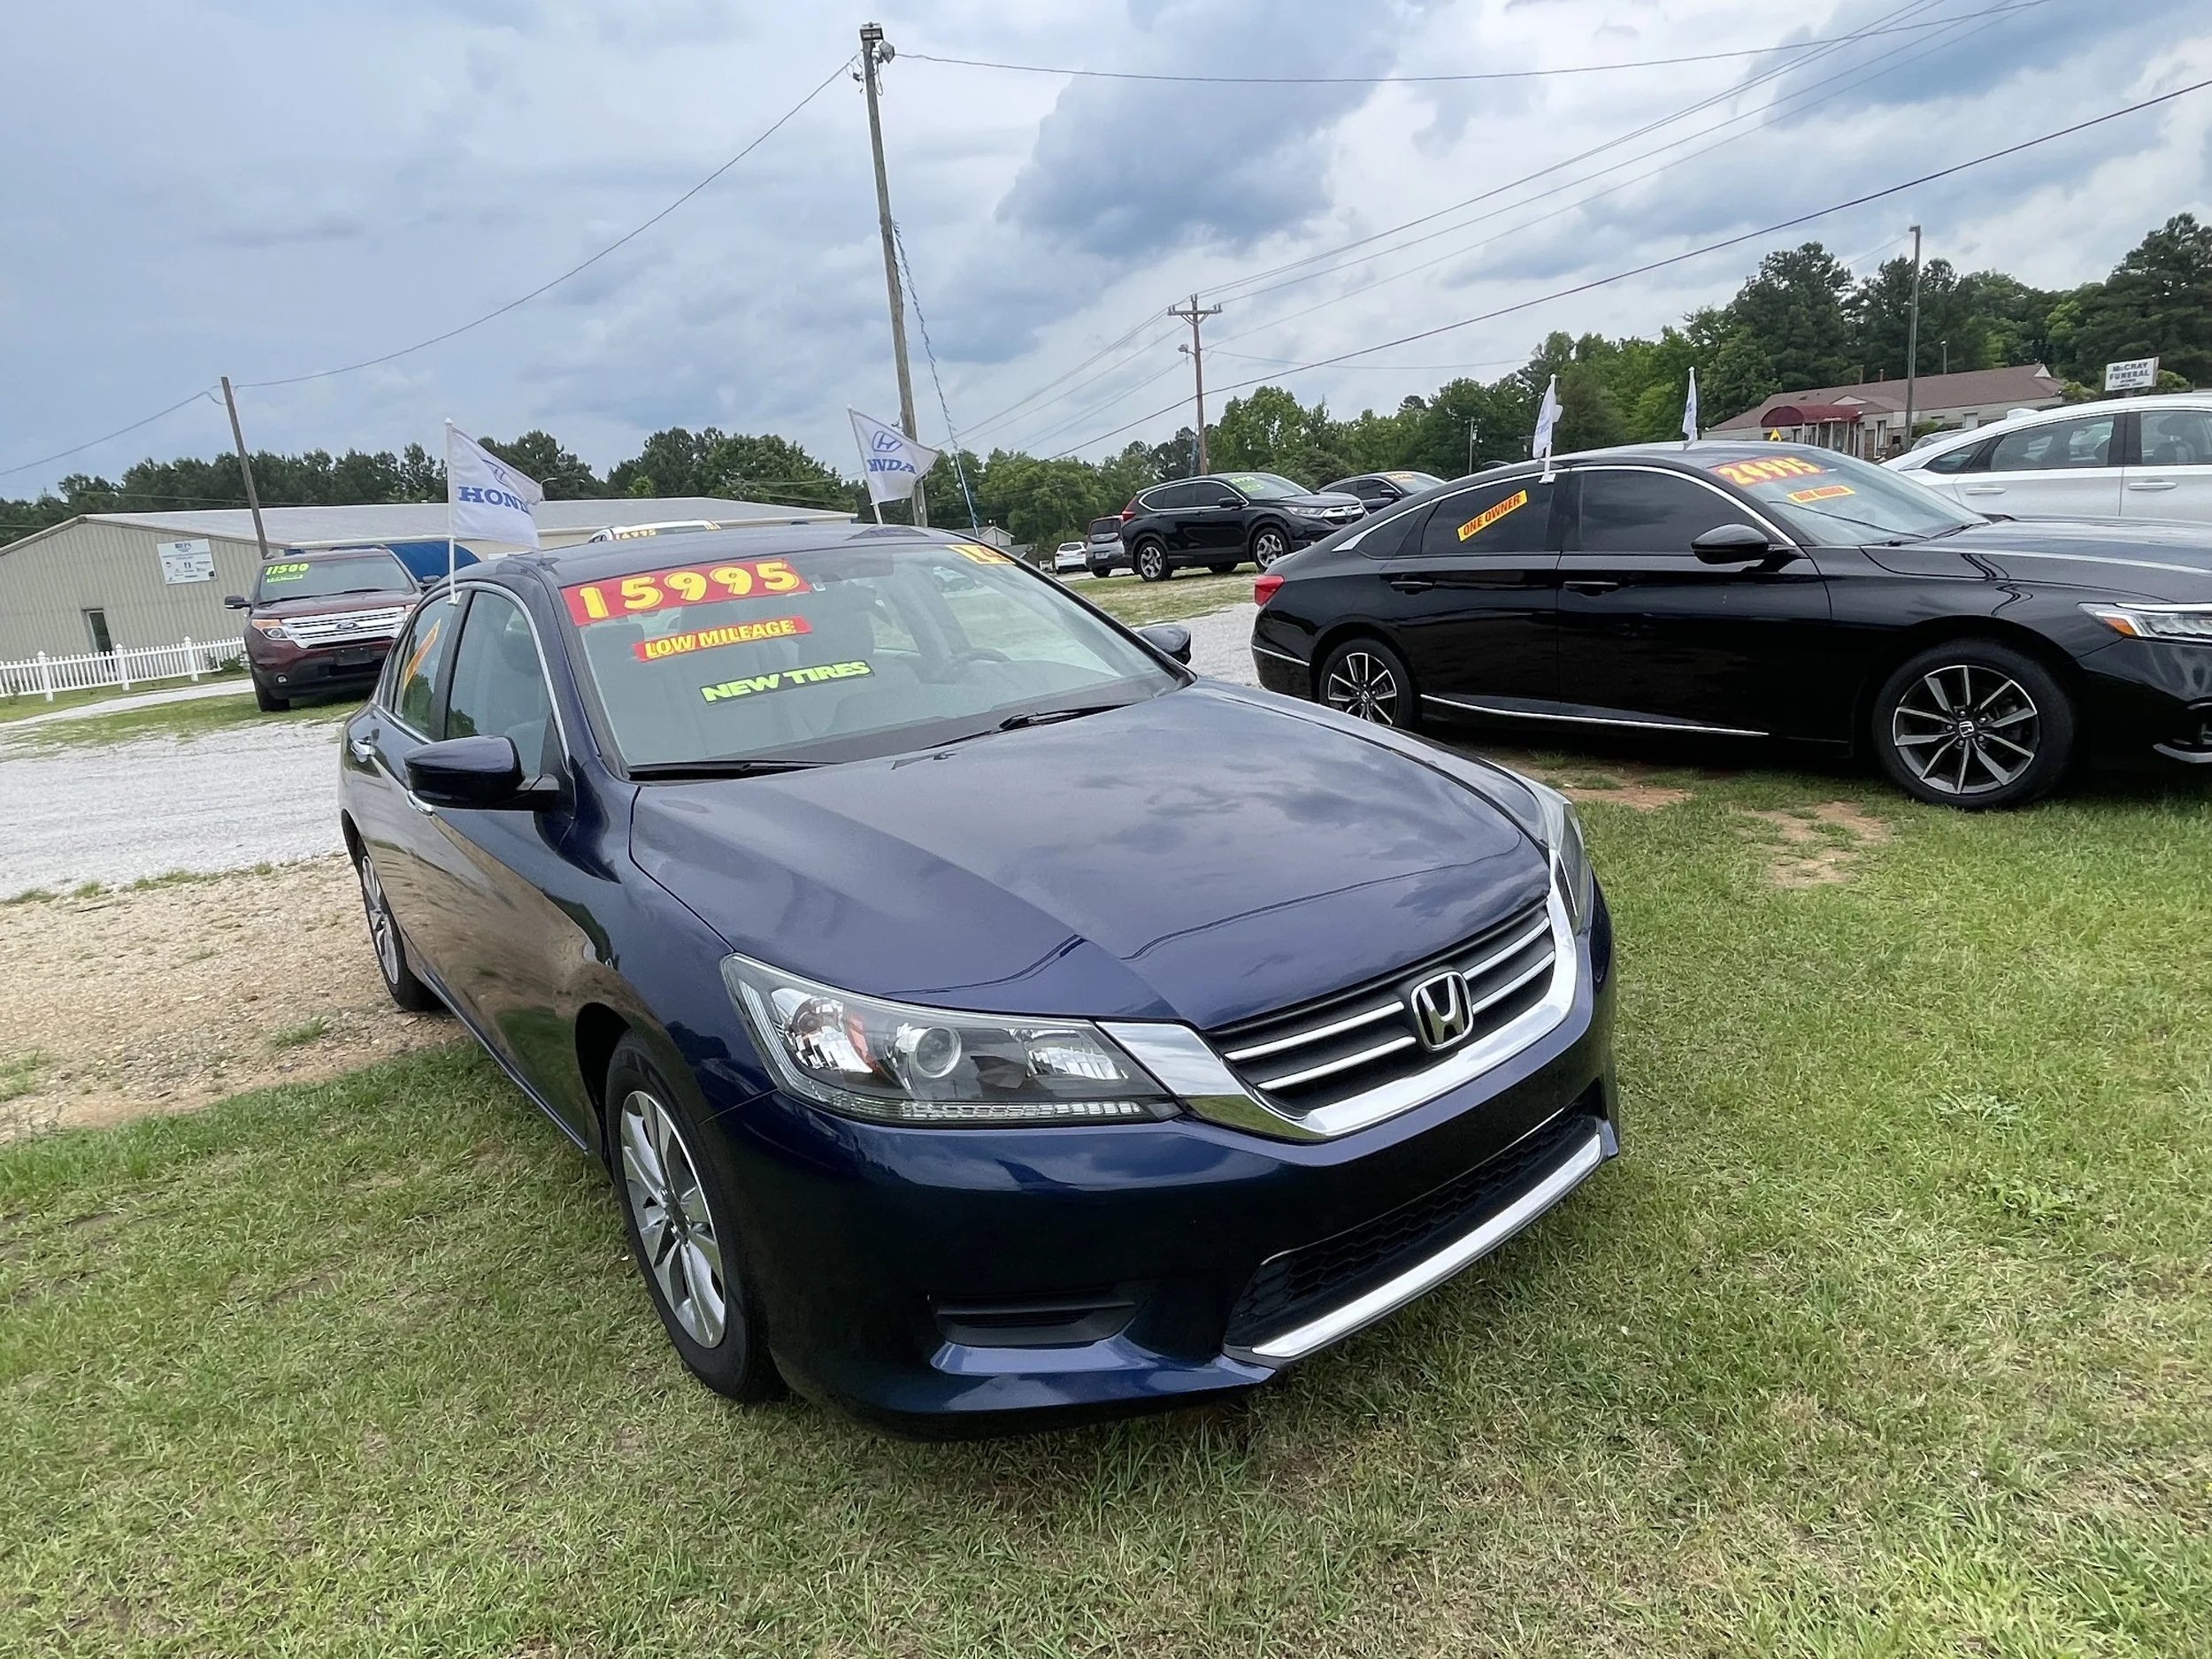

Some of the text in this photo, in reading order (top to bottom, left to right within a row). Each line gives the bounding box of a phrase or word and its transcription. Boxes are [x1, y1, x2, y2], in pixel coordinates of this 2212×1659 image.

[2109, 369, 2150, 380] FUNERAL
[1718, 457, 1820, 485] 24995
[1463, 495, 1520, 536] ONE OWNER
[265, 563, 309, 575] 11500
[580, 561, 800, 619] 15995
[644, 619, 796, 659] LOW MILEAGE
[701, 661, 871, 702] NEW TIRES
